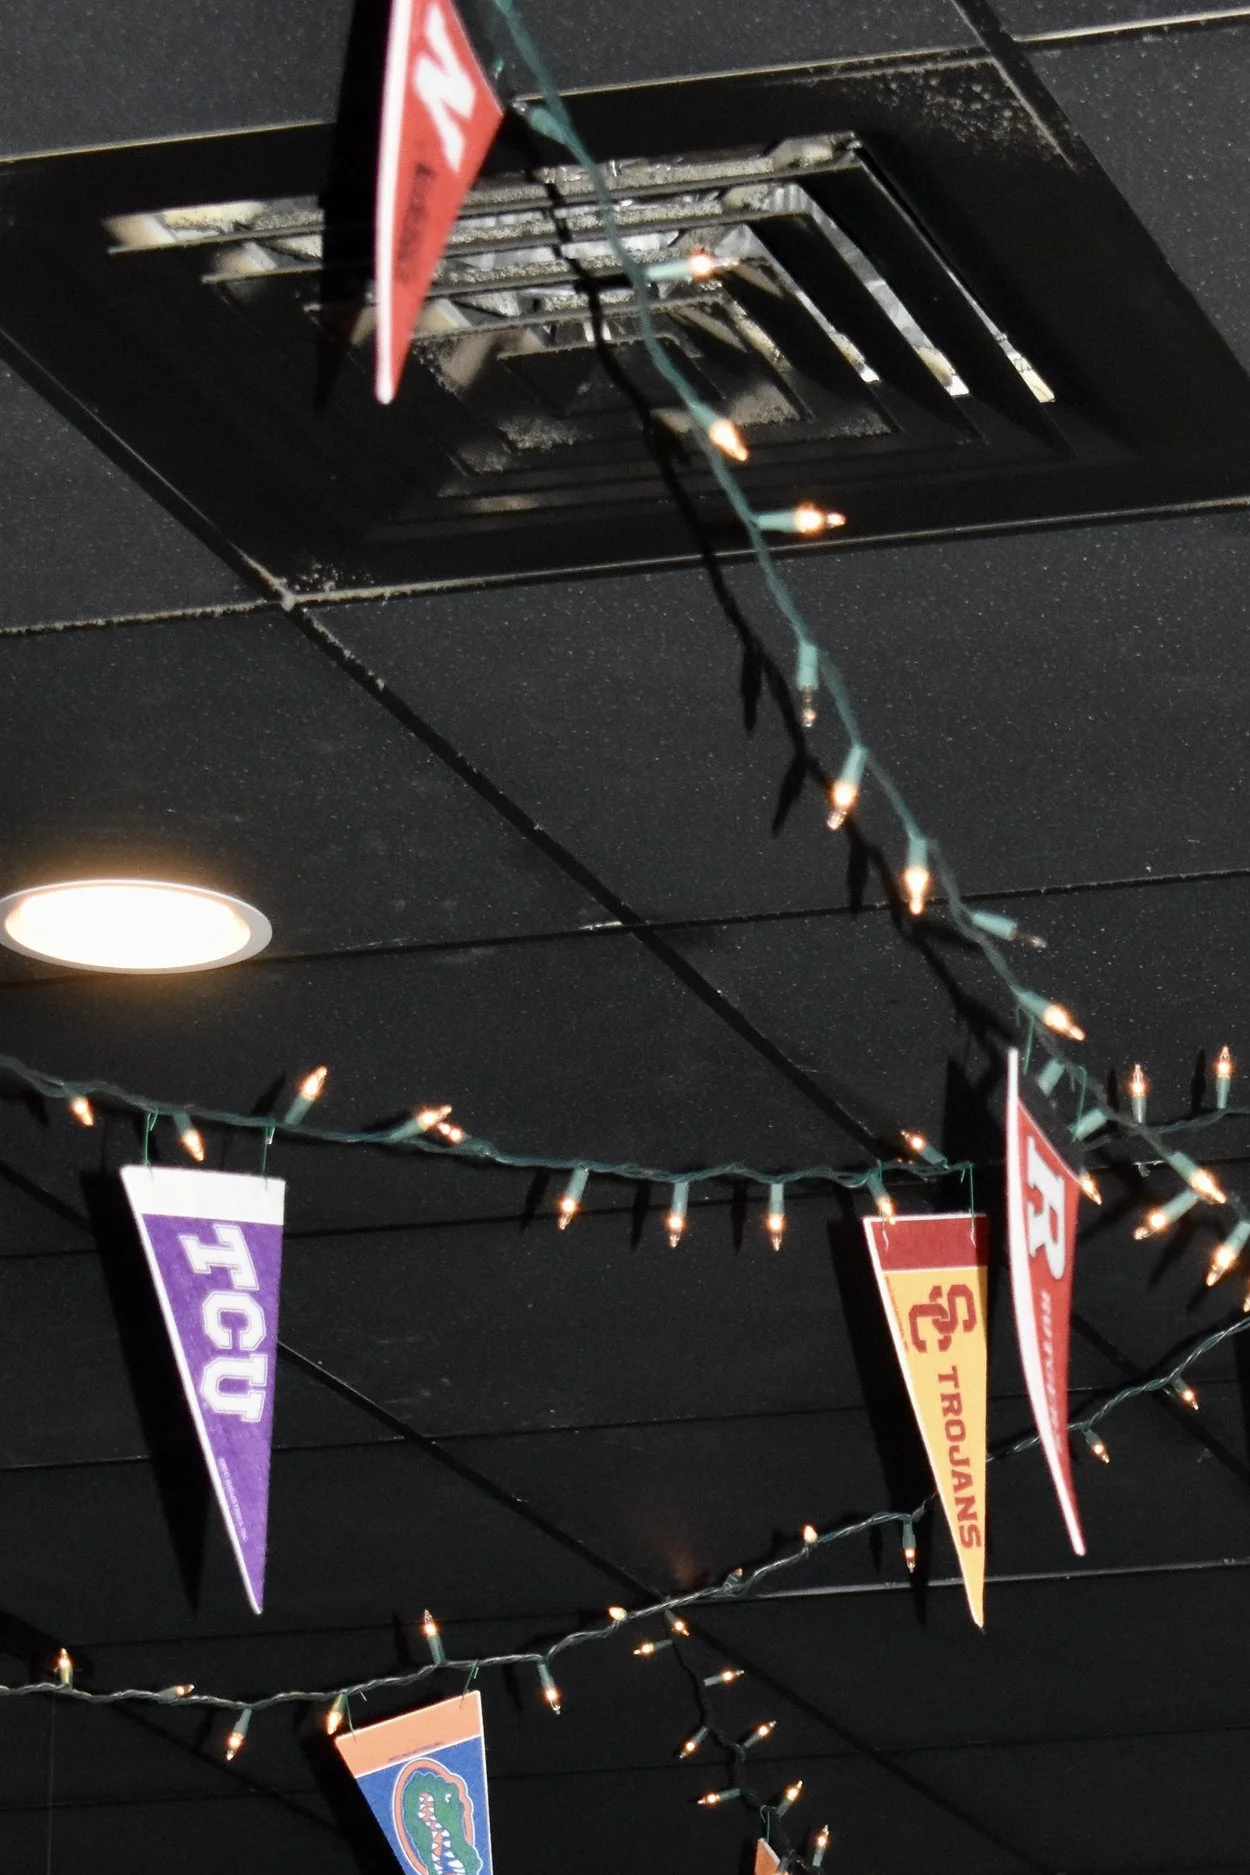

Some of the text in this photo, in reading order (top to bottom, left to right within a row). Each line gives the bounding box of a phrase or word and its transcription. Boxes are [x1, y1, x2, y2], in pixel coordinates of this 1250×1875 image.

[413, 3, 476, 173] N
[1026, 1134, 1066, 1280] R
[179, 1224, 267, 1423] TCU
[937, 1366, 983, 1550] TROJANS
